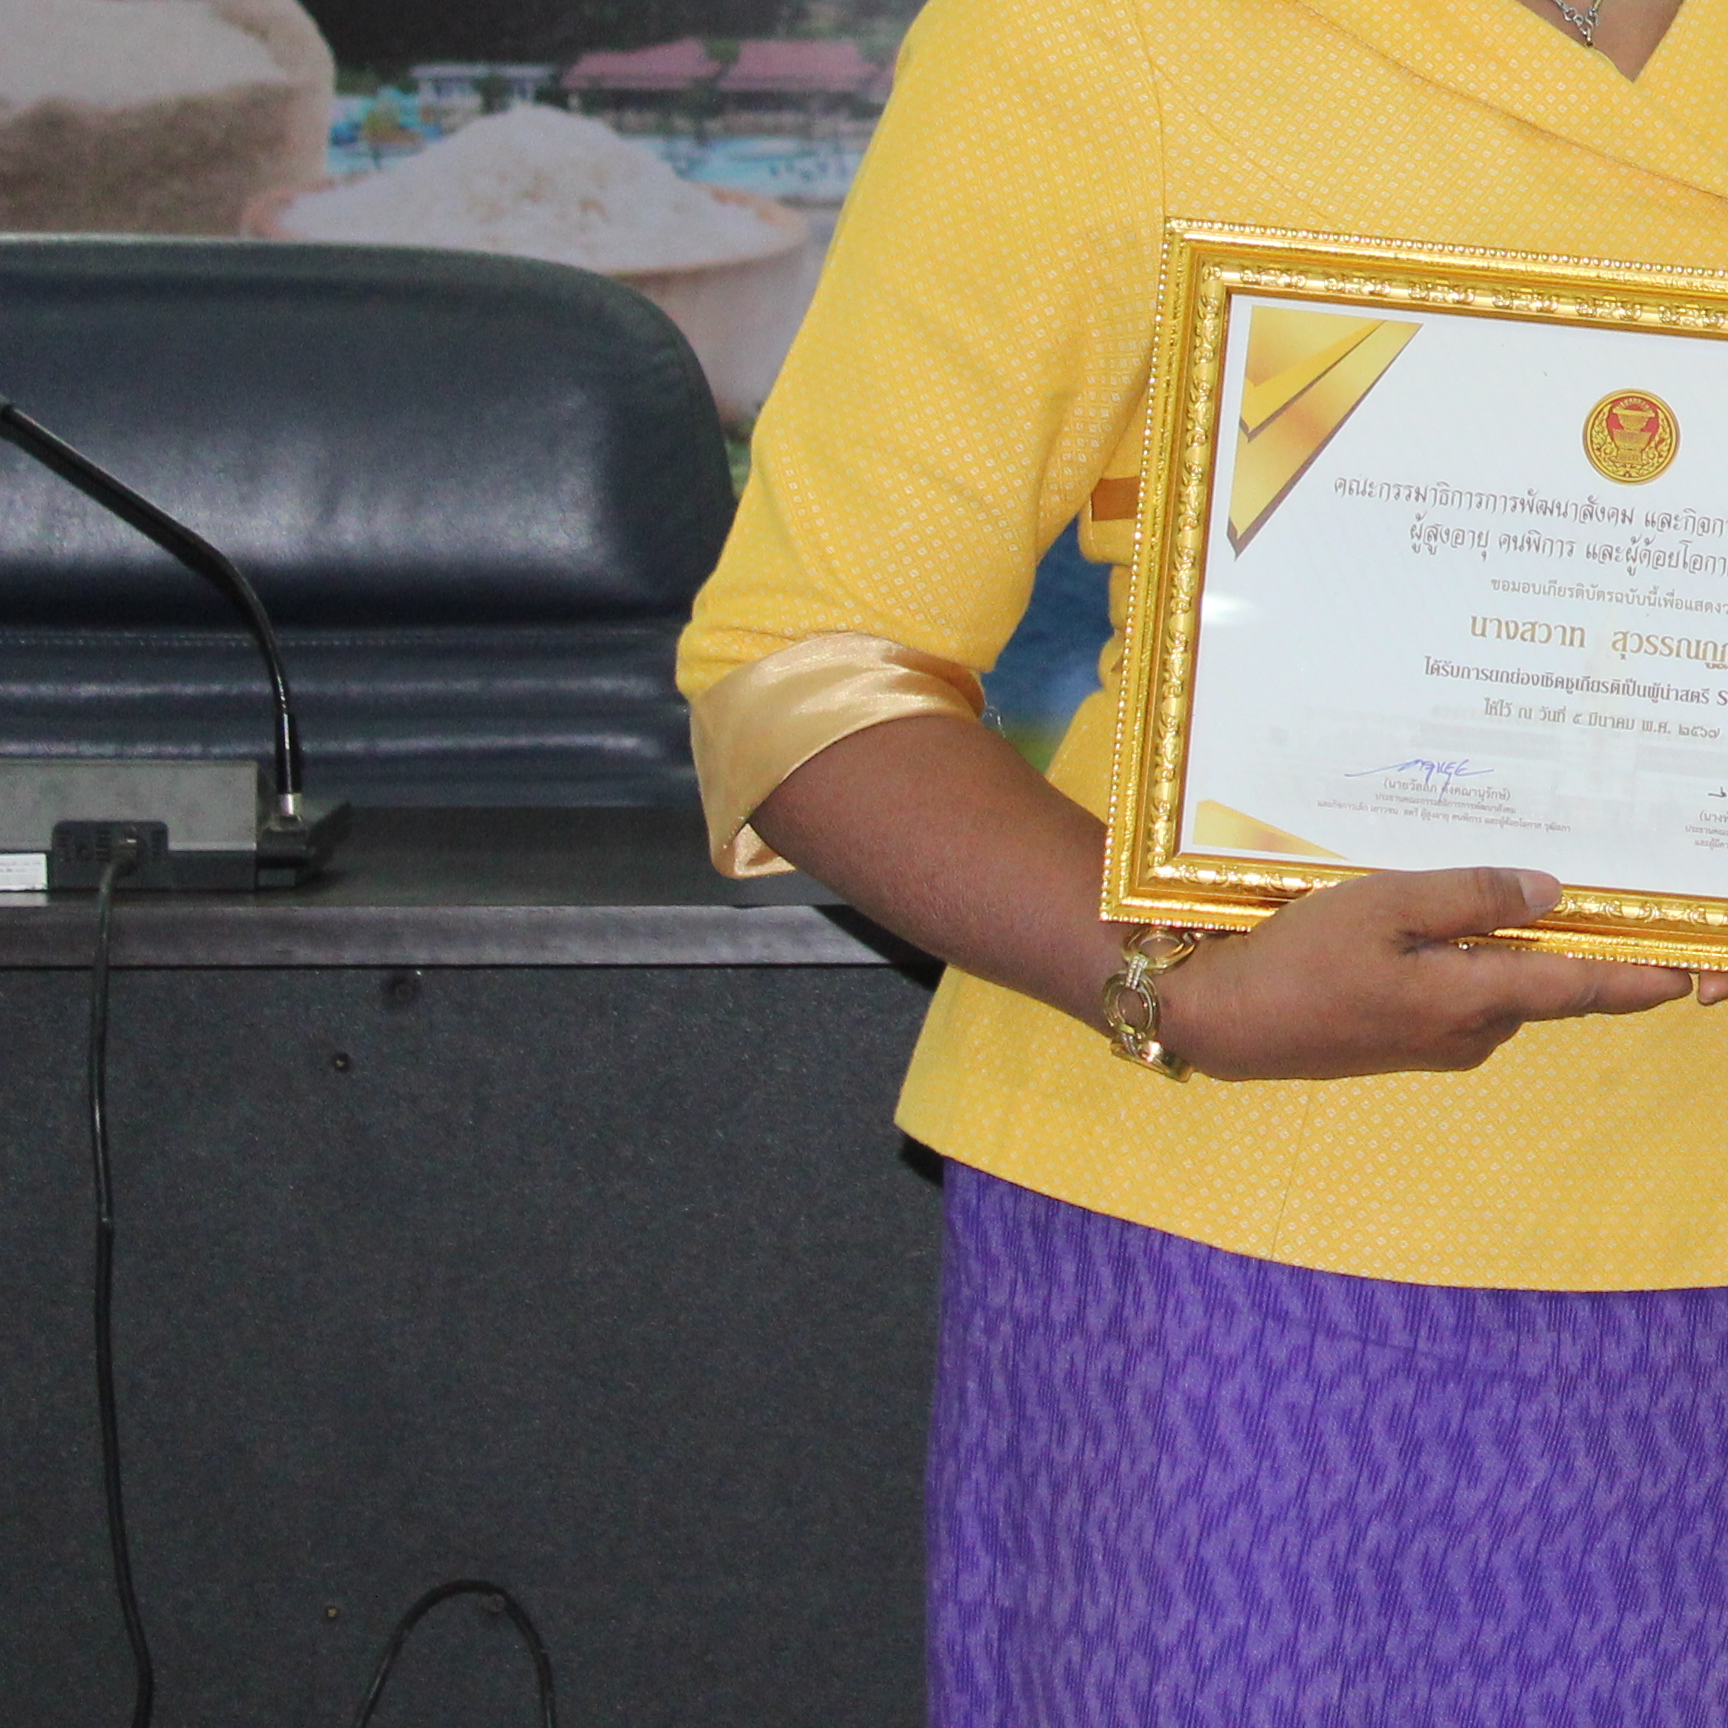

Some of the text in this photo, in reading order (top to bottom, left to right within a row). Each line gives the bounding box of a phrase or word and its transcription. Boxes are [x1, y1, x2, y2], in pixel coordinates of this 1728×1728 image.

[1333, 476, 1634, 525] คณะกรรมาธิการการพัฒนาสังคม
[1410, 511, 1490, 561] ผู้สูงอายุ
[1498, 529, 1577, 559] คนพิการ
[1470, 615, 1587, 649] นางสวาท
[1518, 706, 1533, 720] ณ
[1539, 706, 1568, 724] วันที่
[1588, 712, 1636, 731] มีนาคม
